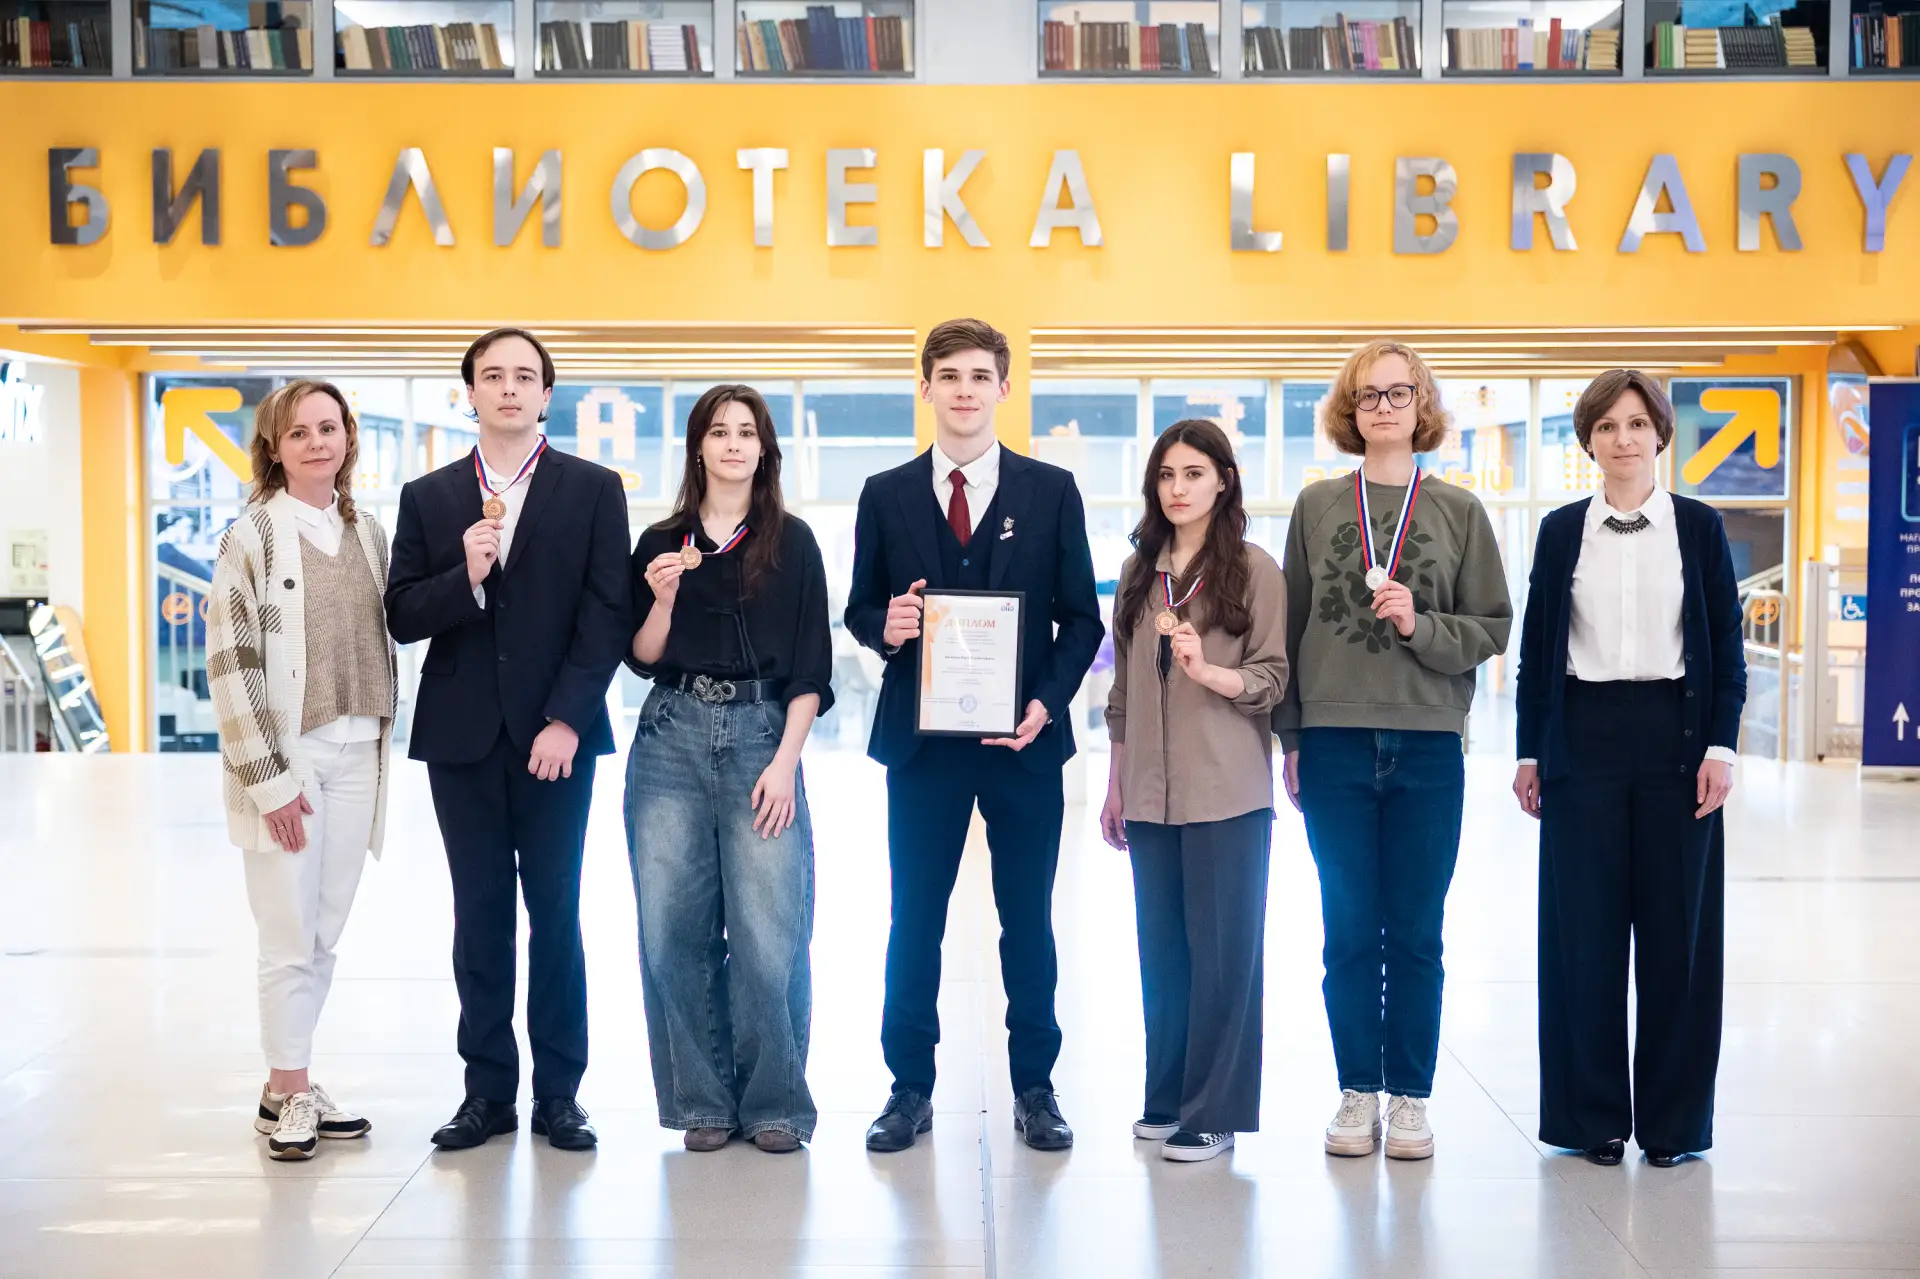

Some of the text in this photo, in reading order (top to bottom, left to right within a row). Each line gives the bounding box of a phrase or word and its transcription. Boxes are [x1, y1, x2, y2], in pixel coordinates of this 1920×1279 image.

[48, 147, 1914, 254] БИБЛИОТЕКА LIBRARY
[1899, 532, 1920, 543] МАГ
[1906, 544, 1920, 554] ПР
[1906, 601, 1920, 612] ЗА
